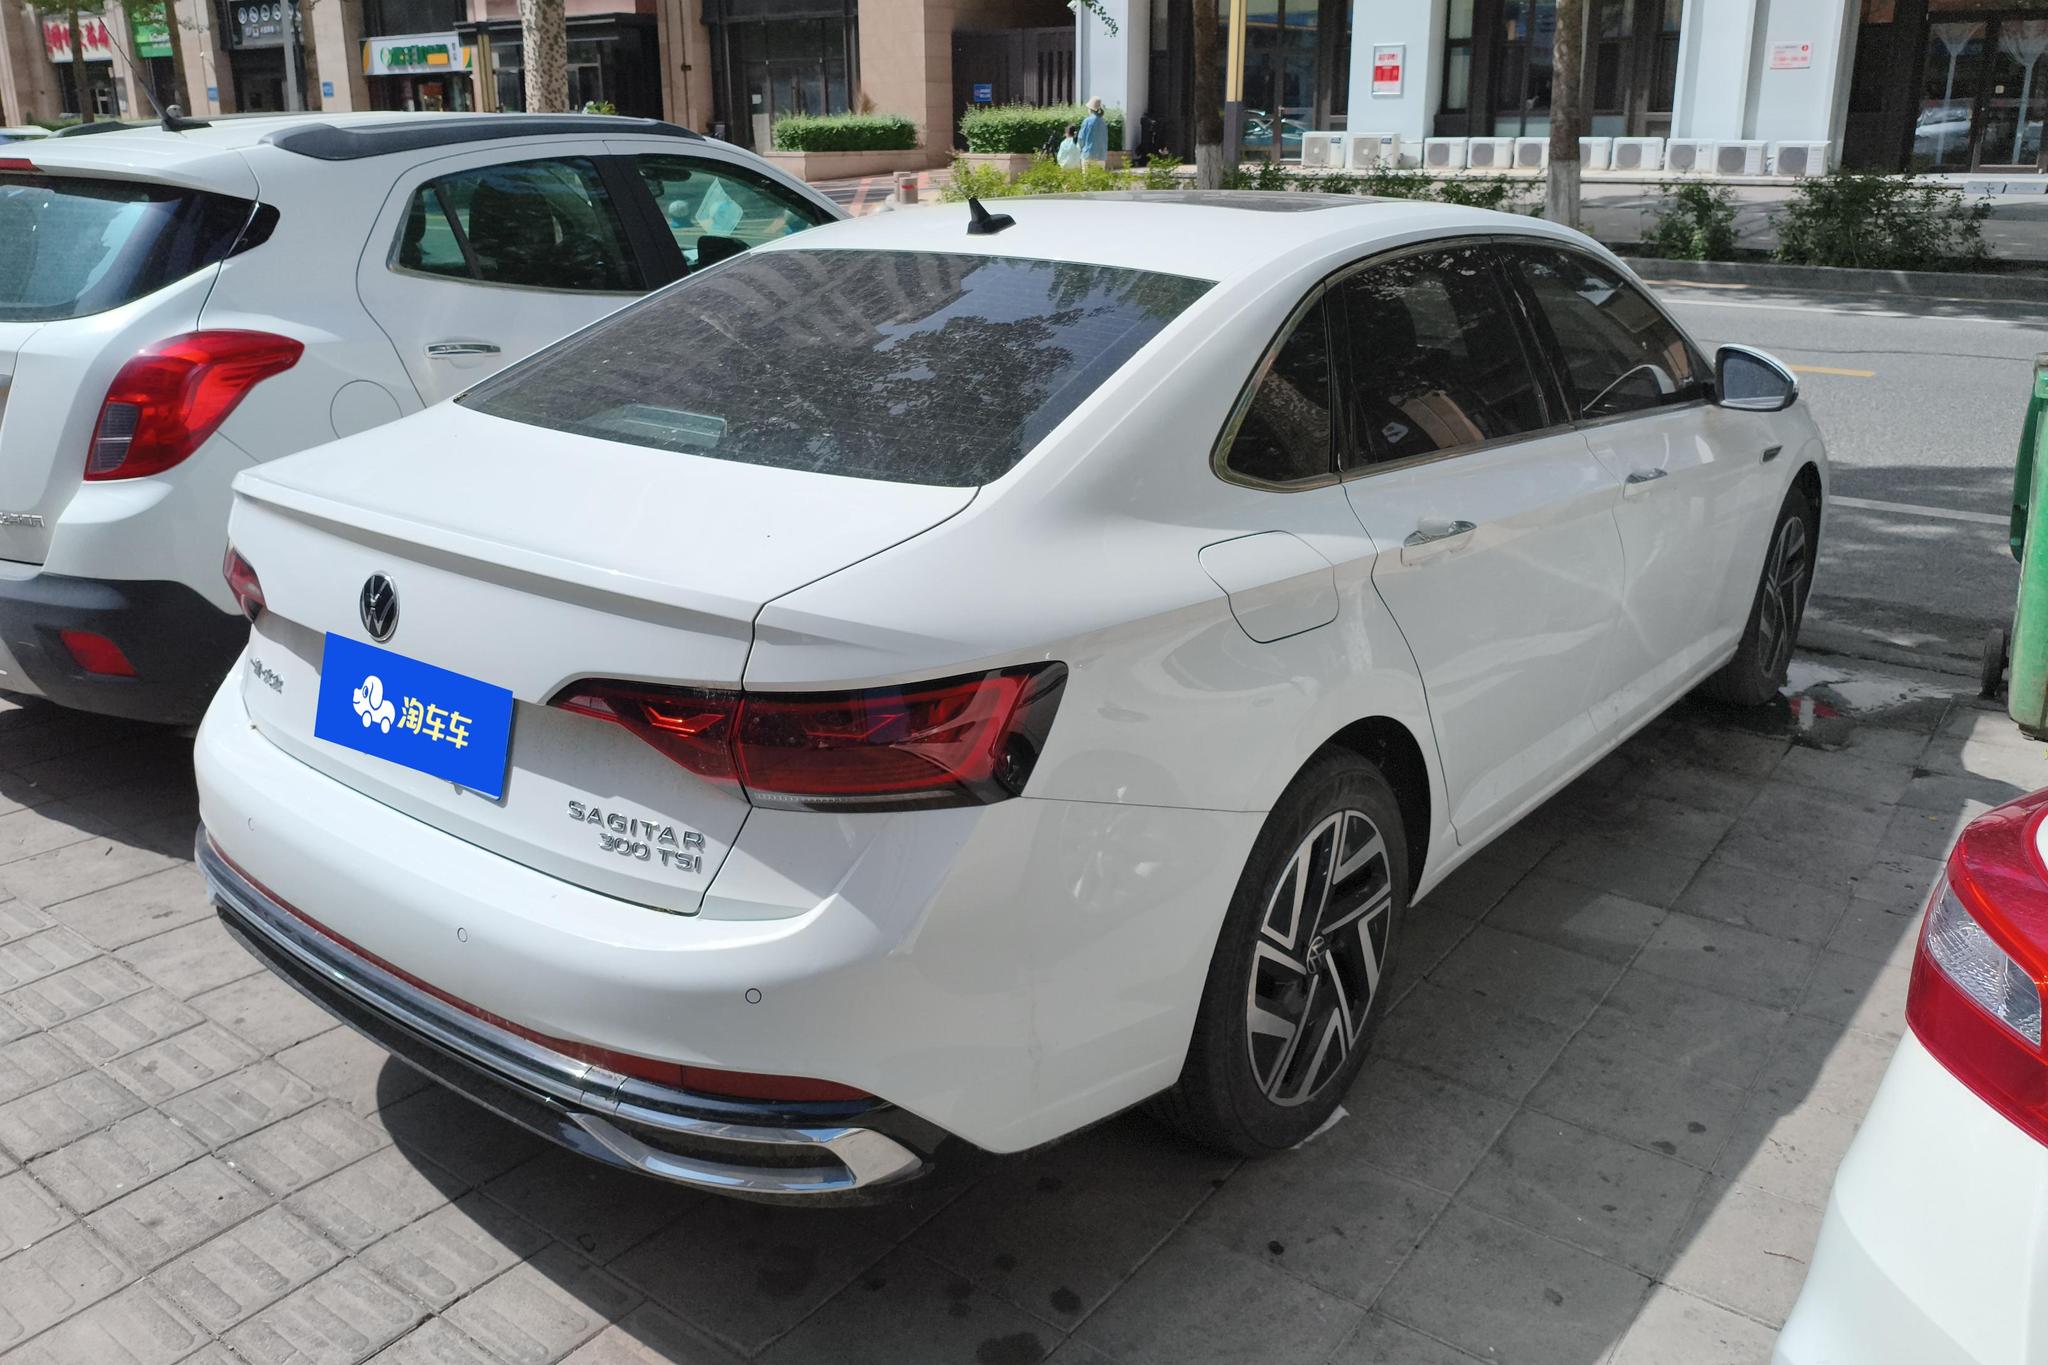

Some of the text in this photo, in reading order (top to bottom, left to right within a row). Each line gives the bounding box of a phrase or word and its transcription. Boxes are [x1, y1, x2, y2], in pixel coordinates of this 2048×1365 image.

[567, 800, 705, 853] SAGITAR
[598, 833, 703, 874] 300 TSI
